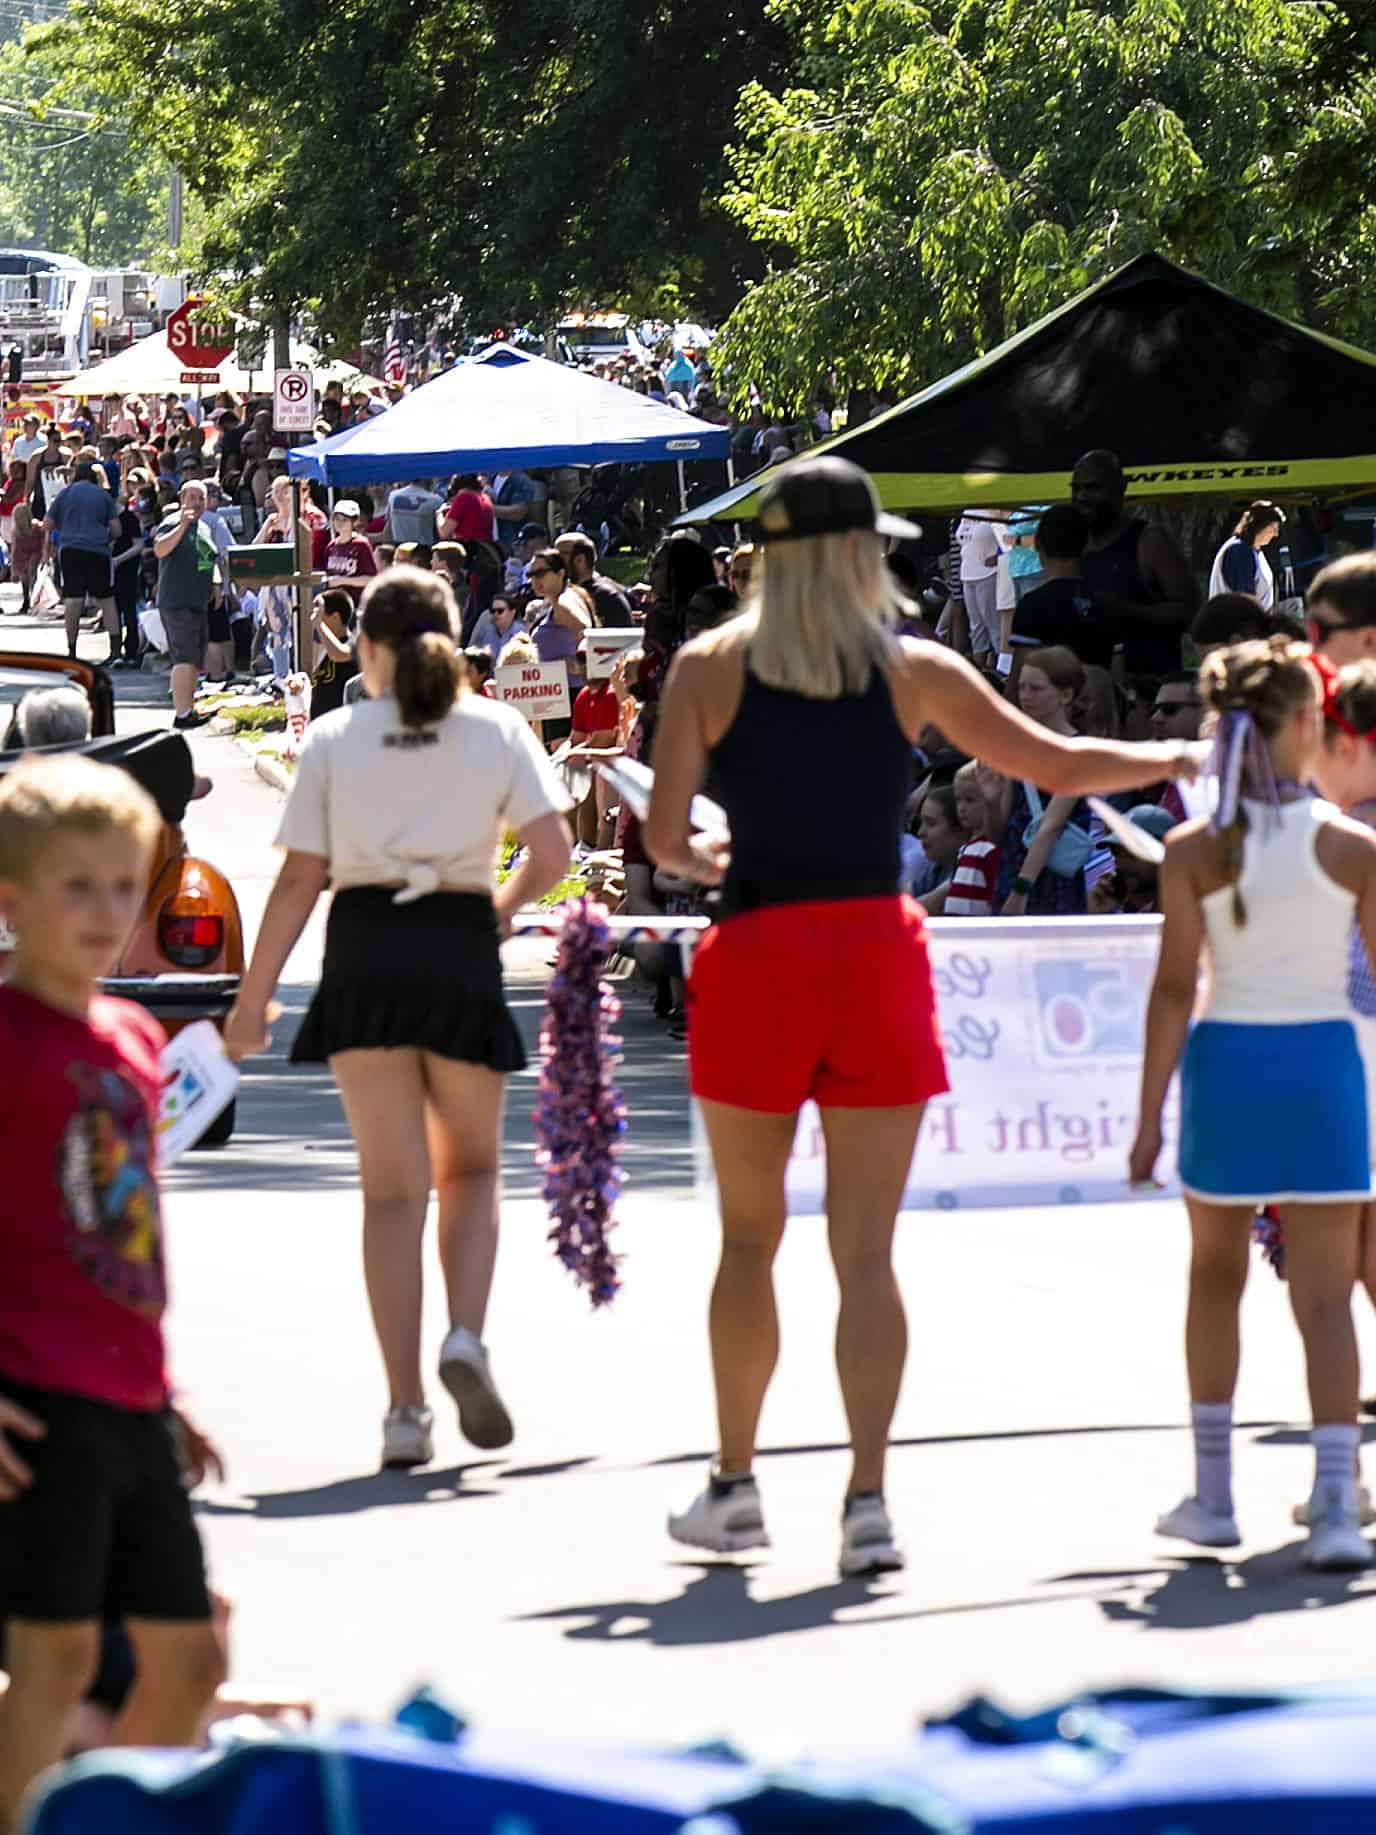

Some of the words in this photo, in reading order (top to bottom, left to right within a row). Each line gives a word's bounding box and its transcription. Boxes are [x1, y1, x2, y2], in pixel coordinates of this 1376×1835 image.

[1124, 465, 1289, 482] WKEYES
[521, 668, 541, 681] NO
[503, 683, 562, 700] PARKING
